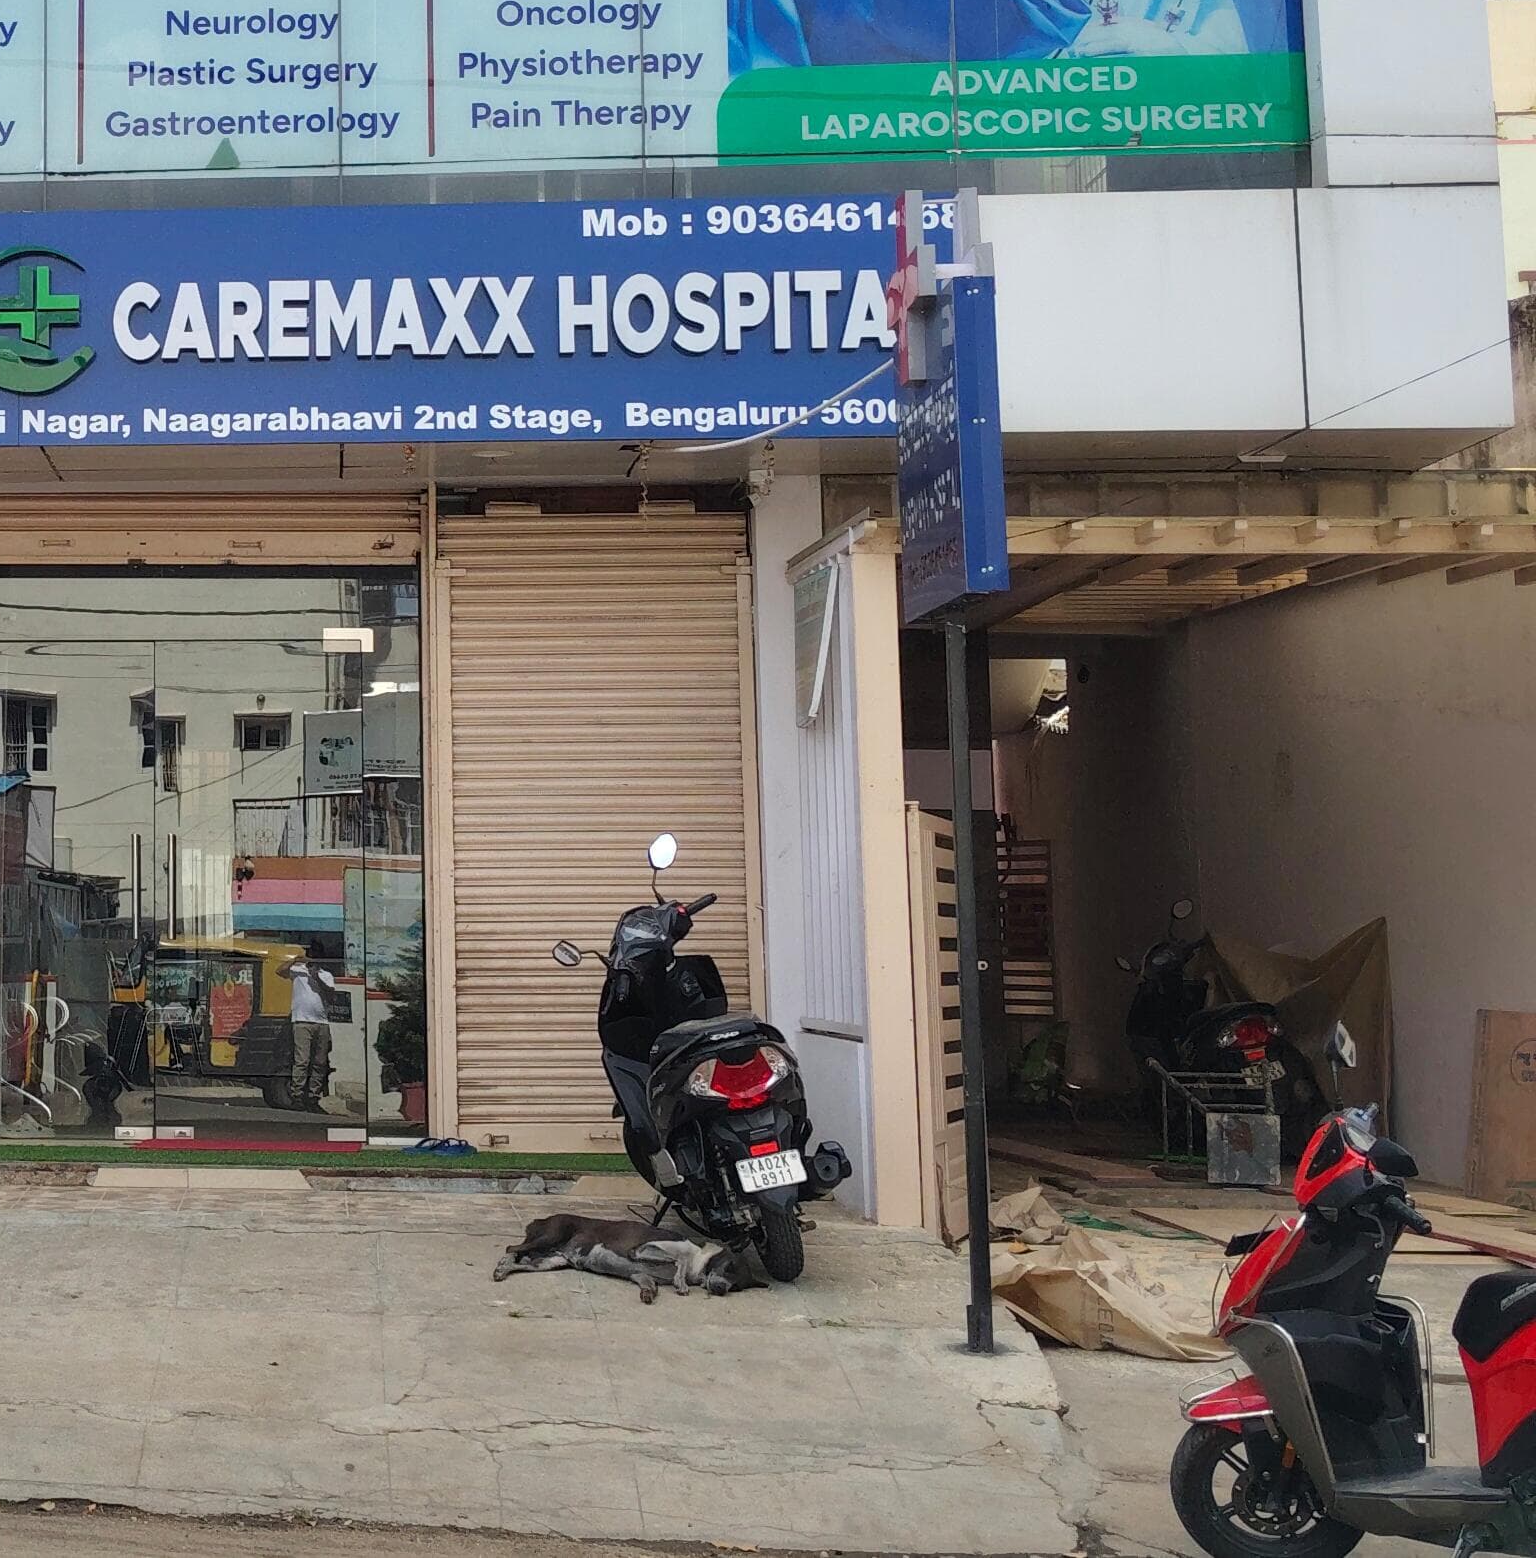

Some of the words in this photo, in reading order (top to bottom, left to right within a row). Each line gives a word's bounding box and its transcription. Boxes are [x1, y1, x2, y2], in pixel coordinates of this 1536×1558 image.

[165, 8, 338, 42] Neurology
[496, 0, 662, 30] Oncology
[128, 57, 235, 87] Plastic
[246, 57, 378, 90] Surgery
[458, 48, 703, 84] Physiotherapy
[930, 66, 1138, 96] ADVANCED
[105, 107, 400, 140] Gastroenterology
[470, 102, 541, 128] Pain
[551, 100, 692, 130] Therapy
[801, 108, 1093, 141] LAPAROSCOPIC
[1100, 101, 1273, 134] SURGERY
[582, 207, 666, 237] Mob
[112, 274, 536, 362] CAREMAXX
[558, 270, 896, 355] HOSPITA
[21, 409, 131, 441] Nagar,
[142, 405, 403, 438] Naagarabhaavi
[413, 405, 478, 430] 2nd
[489, 403, 603, 433] Stage,
[625, 401, 809, 434] Bengaluru
[748, 1154, 790, 1174] KA02K
[752, 1169, 794, 1188] L8911
